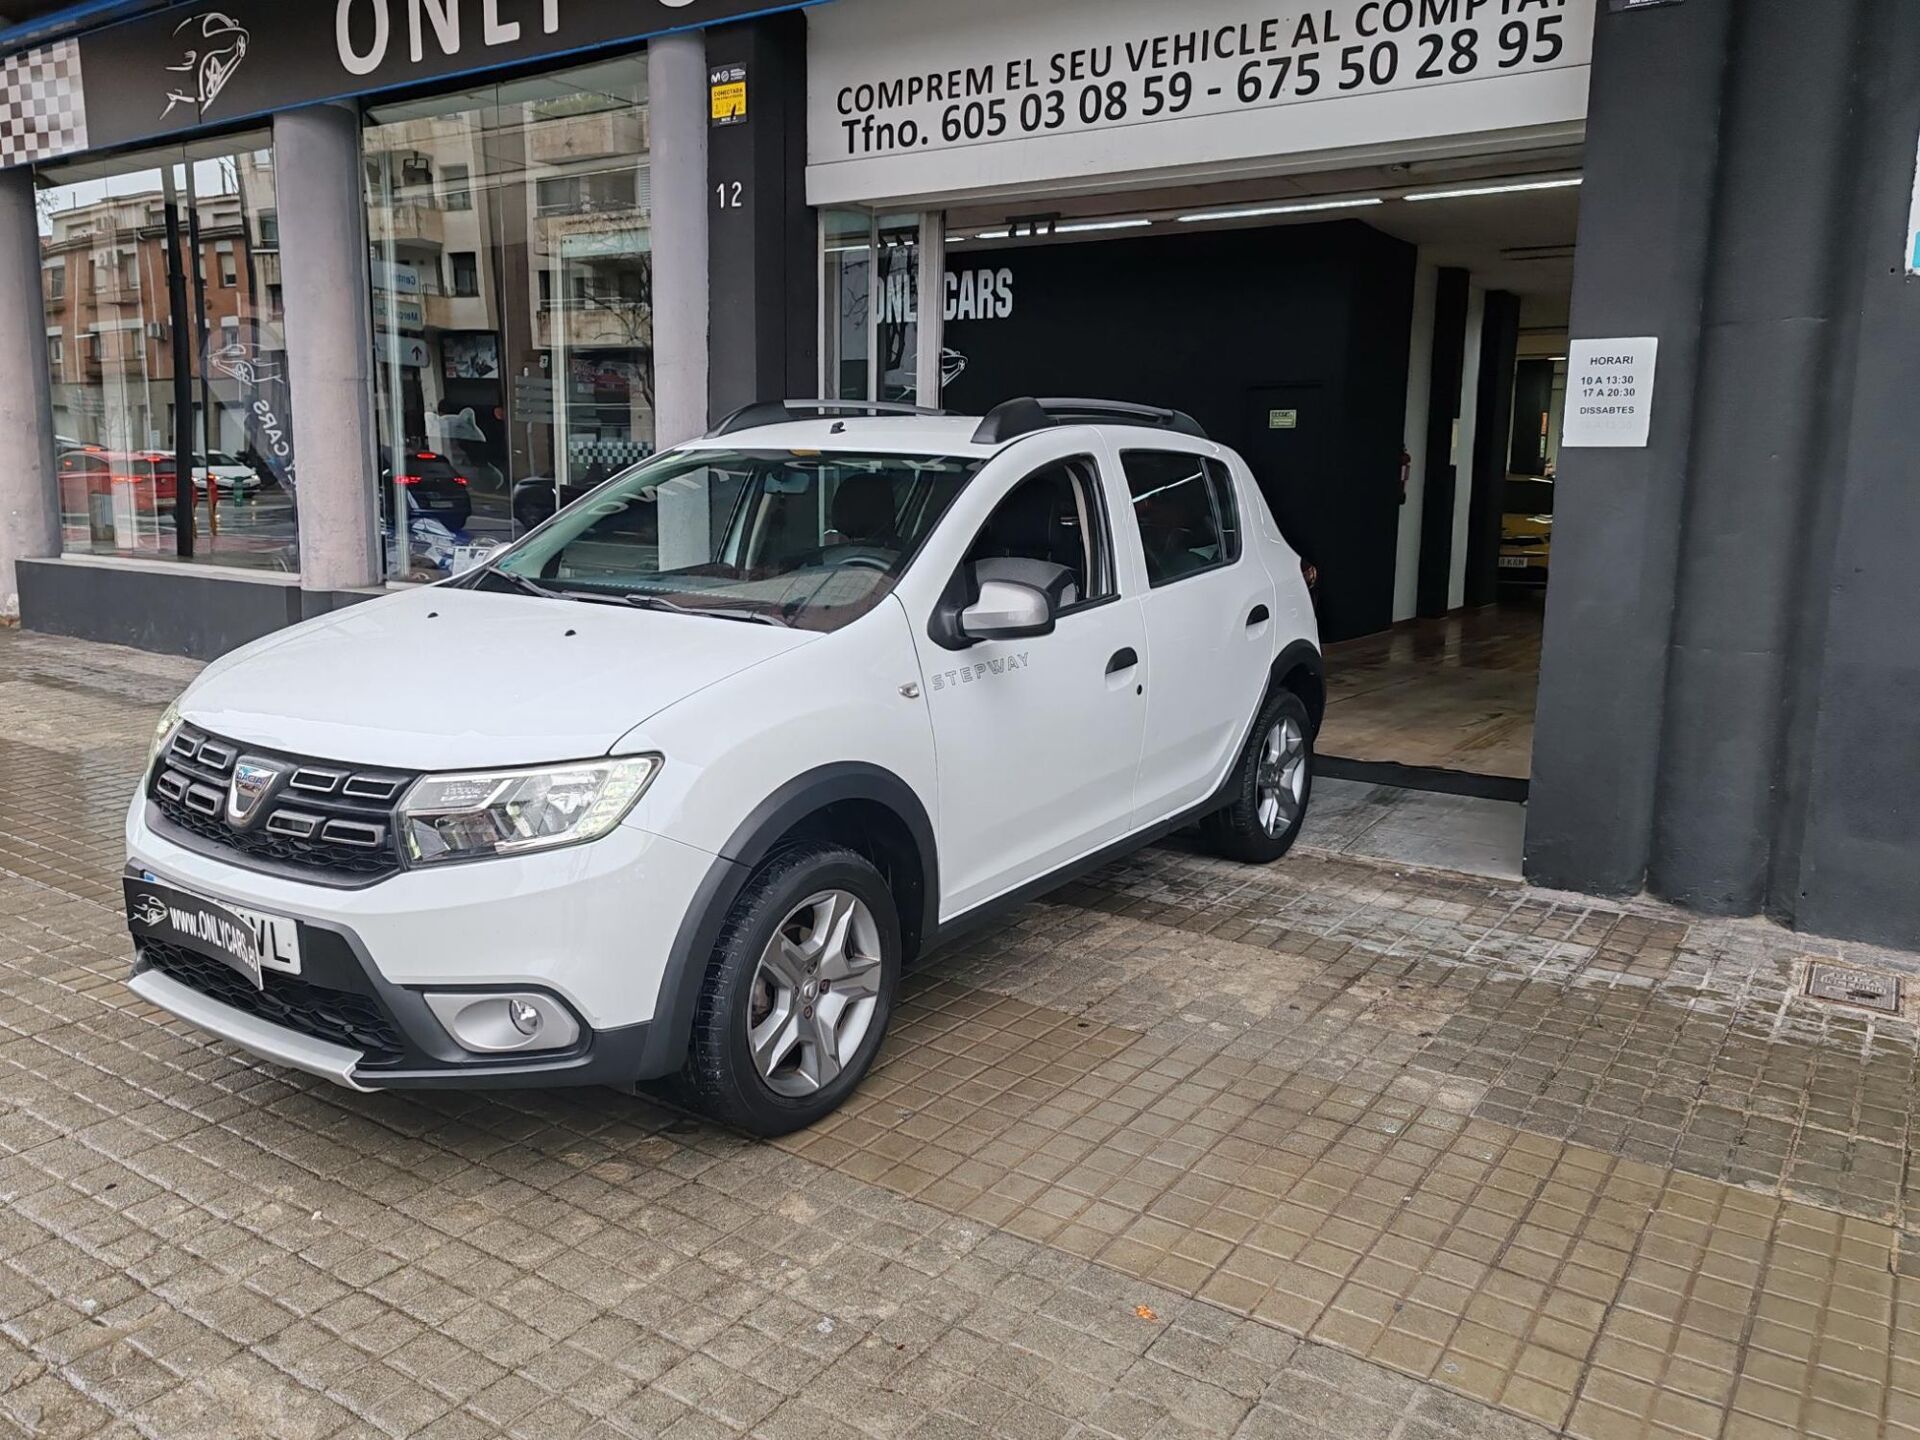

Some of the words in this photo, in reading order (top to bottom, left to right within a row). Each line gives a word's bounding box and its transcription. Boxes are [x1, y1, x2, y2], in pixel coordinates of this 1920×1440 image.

[836, 65, 994, 115] COMPREM
[1005, 58, 1039, 91] EL
[1049, 45, 1112, 85] SEU
[1124, 18, 1279, 72] VEHICLE
[1290, 9, 1340, 48] AL
[842, 115, 929, 154] Tfno.
[941, 98, 1007, 142] 605
[1020, 90, 1065, 132] 03
[1079, 81, 1127, 124] 08
[1142, 71, 1192, 117] 59
[1207, 86, 1222, 96] -
[1237, 52, 1320, 103] 675
[1338, 42, 1399, 90] 50
[1415, 28, 1479, 80] 28
[1498, 14, 1564, 69] 95
[716, 181, 742, 209] 12
[944, 268, 1013, 321] CARS
[1589, 355, 1634, 366] HORARI
[1581, 376, 1593, 386] 10
[1595, 376, 1603, 385] A
[1606, 375, 1634, 385] 13:30
[1583, 388, 1594, 397] 17
[1596, 388, 1604, 397] A
[1607, 387, 1636, 397] 20:30
[1579, 405, 1635, 415] DISSABTES
[931, 651, 1029, 691] STEPWAY
